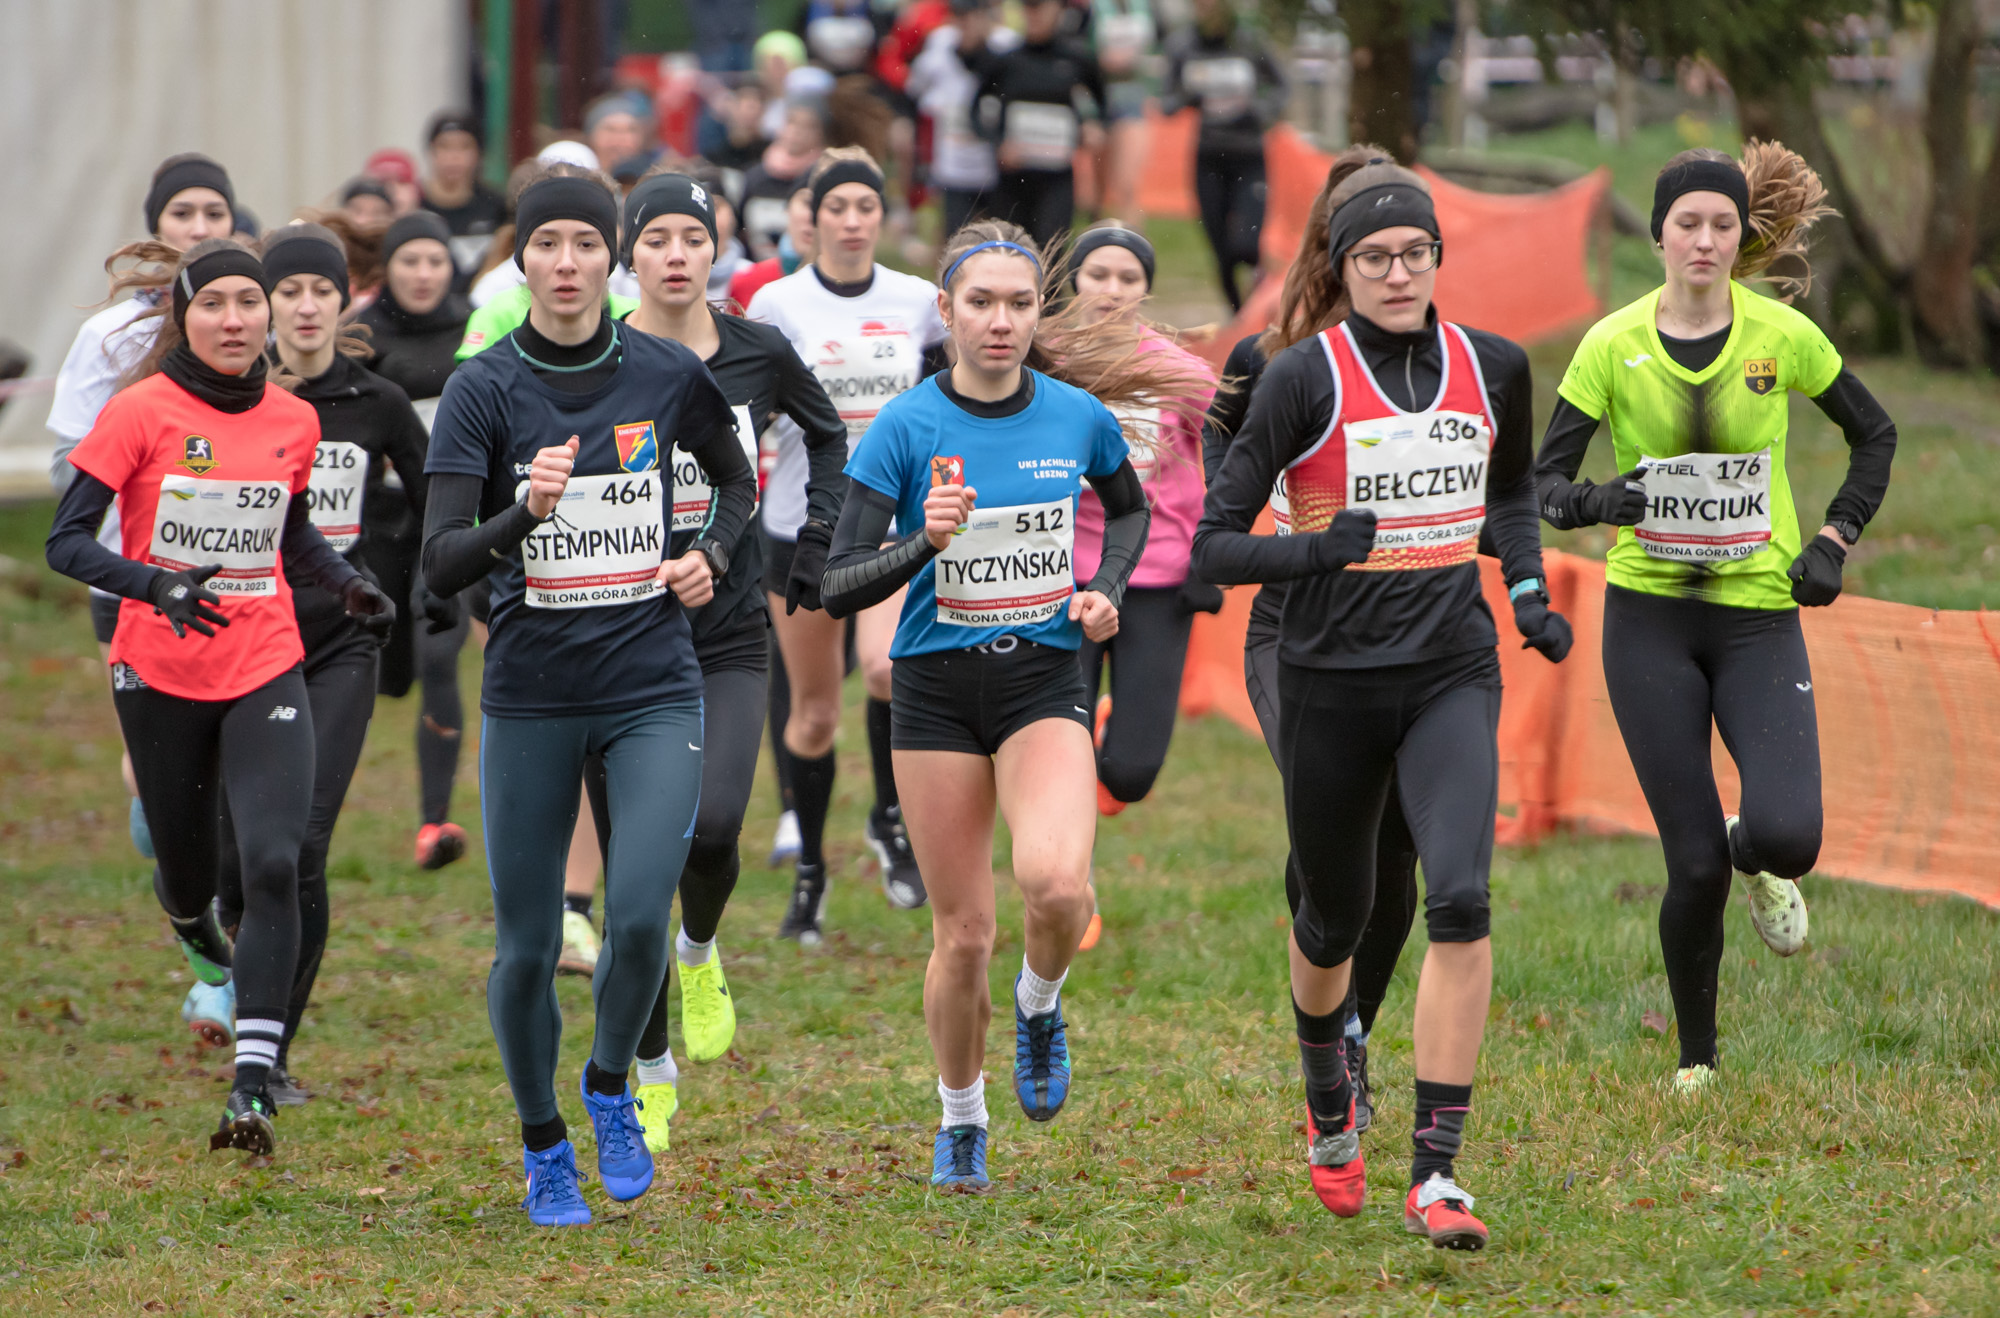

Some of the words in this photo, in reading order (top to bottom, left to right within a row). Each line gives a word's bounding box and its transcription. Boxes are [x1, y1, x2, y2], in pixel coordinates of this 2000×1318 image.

[873, 341, 896, 358] 28
[1757, 379, 1766, 390] S
[1429, 418, 1478, 443] 436
[312, 447, 356, 469] 216
[1018, 460, 1037, 469] UKS
[1040, 458, 1077, 468] ACHILLES
[1717, 455, 1761, 480] 176
[1034, 470, 1069, 479] LESZNO
[1355, 461, 1484, 503] BEŁCZEW
[236, 486, 281, 509] 529
[601, 478, 652, 506] 464
[1015, 508, 1064, 533] 512
[1417, 527, 1452, 540] GÓRA
[1455, 523, 1477, 536] 2023
[161, 520, 278, 553] OWCZARUK
[526, 523, 659, 561] STEMPNIAK
[1643, 542, 1693, 556] ZIELONA
[1695, 546, 1730, 557] GÓRA
[940, 548, 1069, 585] TYCZYŃSKA
[209, 579, 242, 591] GÓRA
[244, 581, 267, 591] 2023
[537, 592, 589, 603] ZIELONA
[591, 587, 628, 600] GÓRA
[631, 582, 654, 596] 2023
[949, 610, 1000, 623] ZIELONA
[1002, 608, 1038, 621] GÓRA
